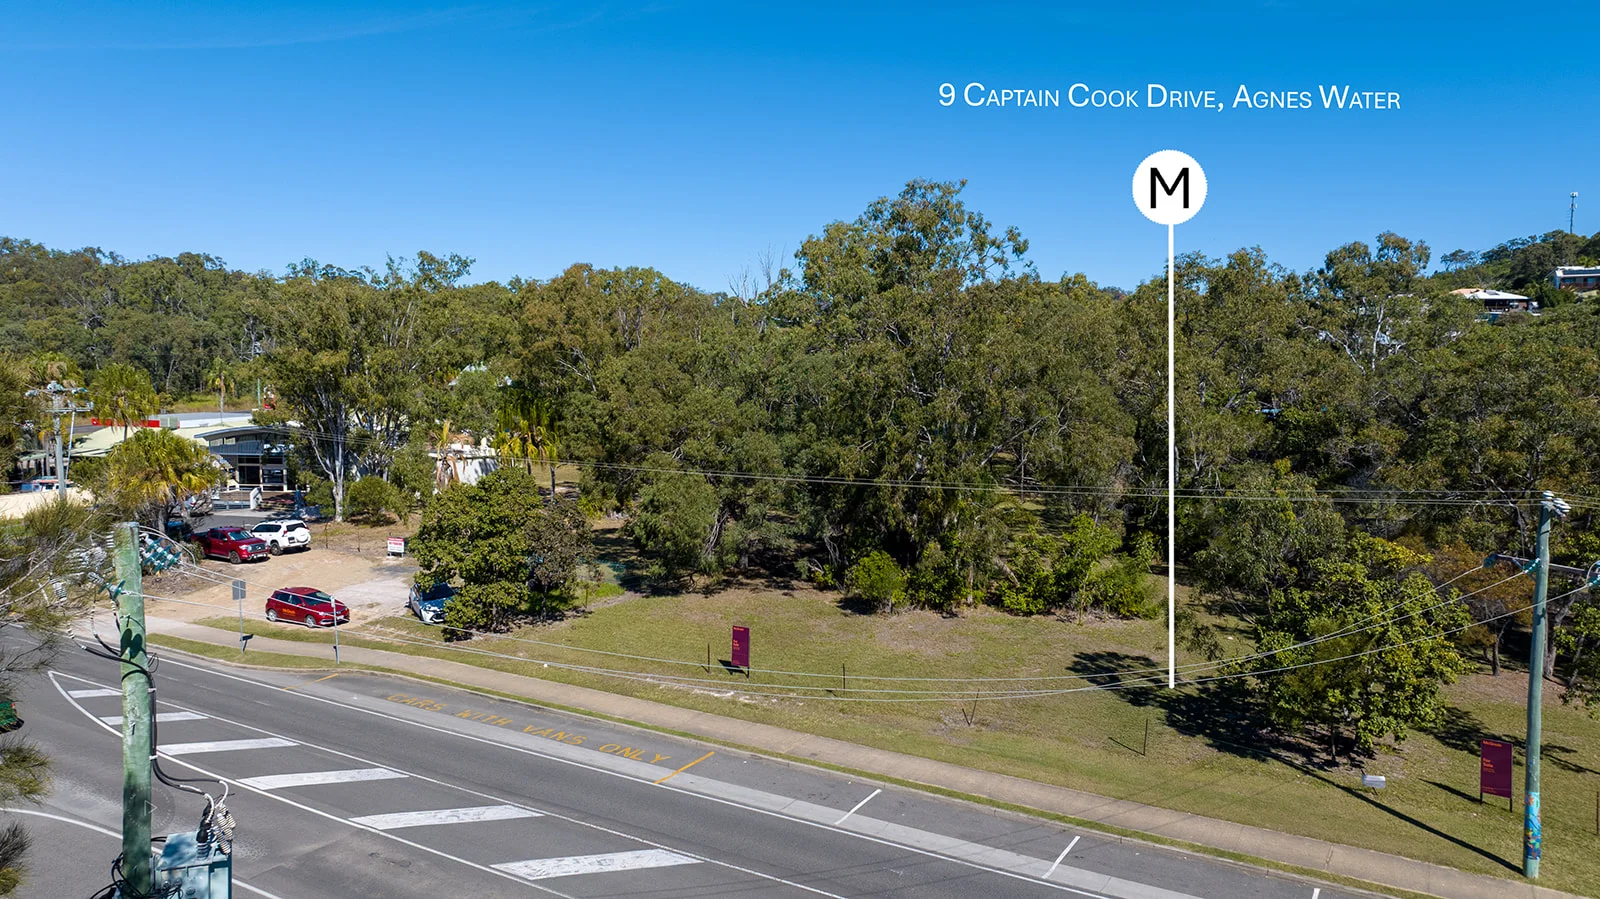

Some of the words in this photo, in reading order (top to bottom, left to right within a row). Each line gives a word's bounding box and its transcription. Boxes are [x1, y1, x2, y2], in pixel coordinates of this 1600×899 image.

[387, 693, 446, 712] CARS
[456, 709, 513, 726] WITH
[523, 725, 587, 745] VANS
[599, 743, 671, 764] ONLY
